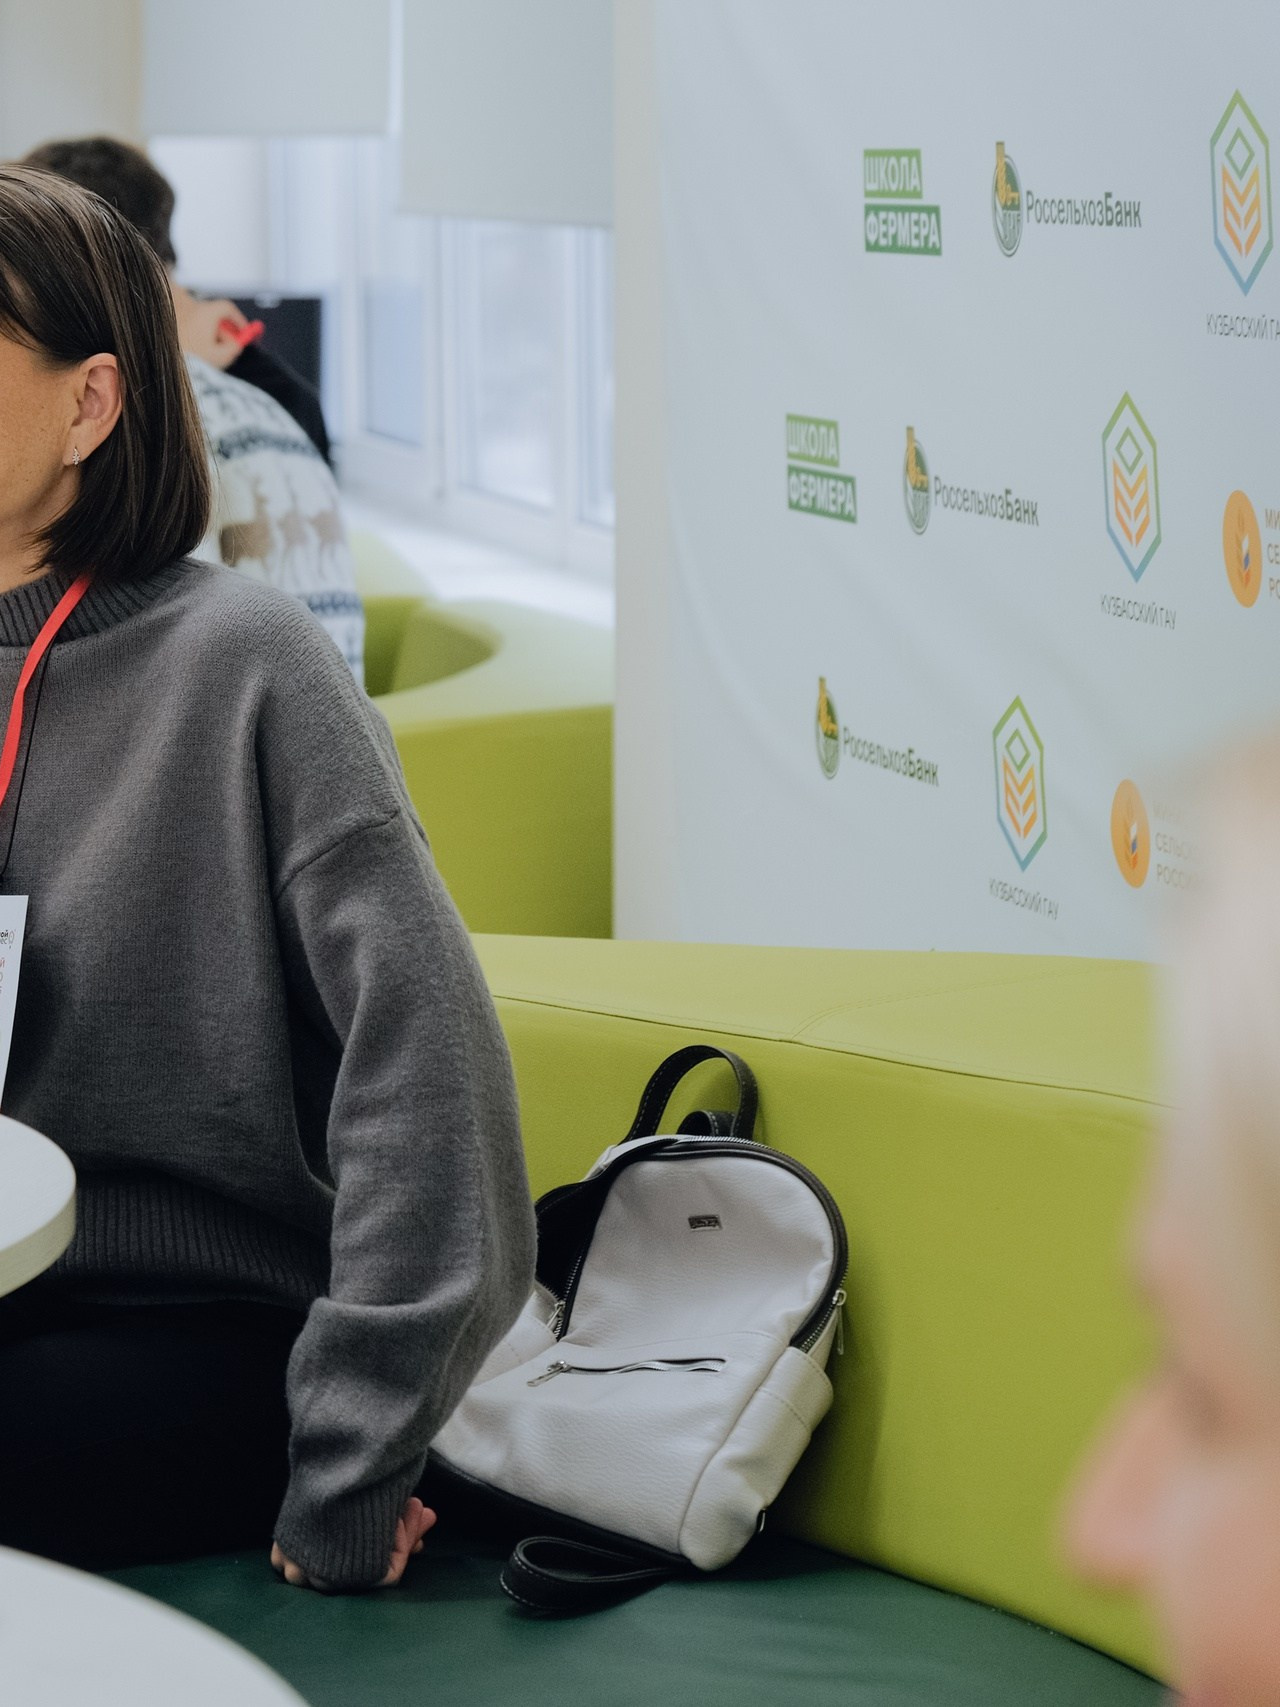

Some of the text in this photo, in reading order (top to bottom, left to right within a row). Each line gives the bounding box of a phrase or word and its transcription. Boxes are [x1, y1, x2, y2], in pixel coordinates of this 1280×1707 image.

[864, 156, 921, 193] ШКОЛА
[1026, 190, 1142, 228] РоссельхозБанк
[866, 210, 941, 250] ФЕРМЕРА
[1206, 313, 1268, 340] КУЗБАССКИЙ
[787, 419, 838, 460] ШКОЛА
[788, 471, 856, 518] ФЕРМЕРА
[934, 476, 1039, 526] РоссельхозБанк
[1100, 594, 1177, 630] КУЗБАССКИЙ ГАУ
[843, 726, 939, 787] РоссельхозБанк
[989, 878, 1060, 920] КУЗБАССКИЙ ГАУ
